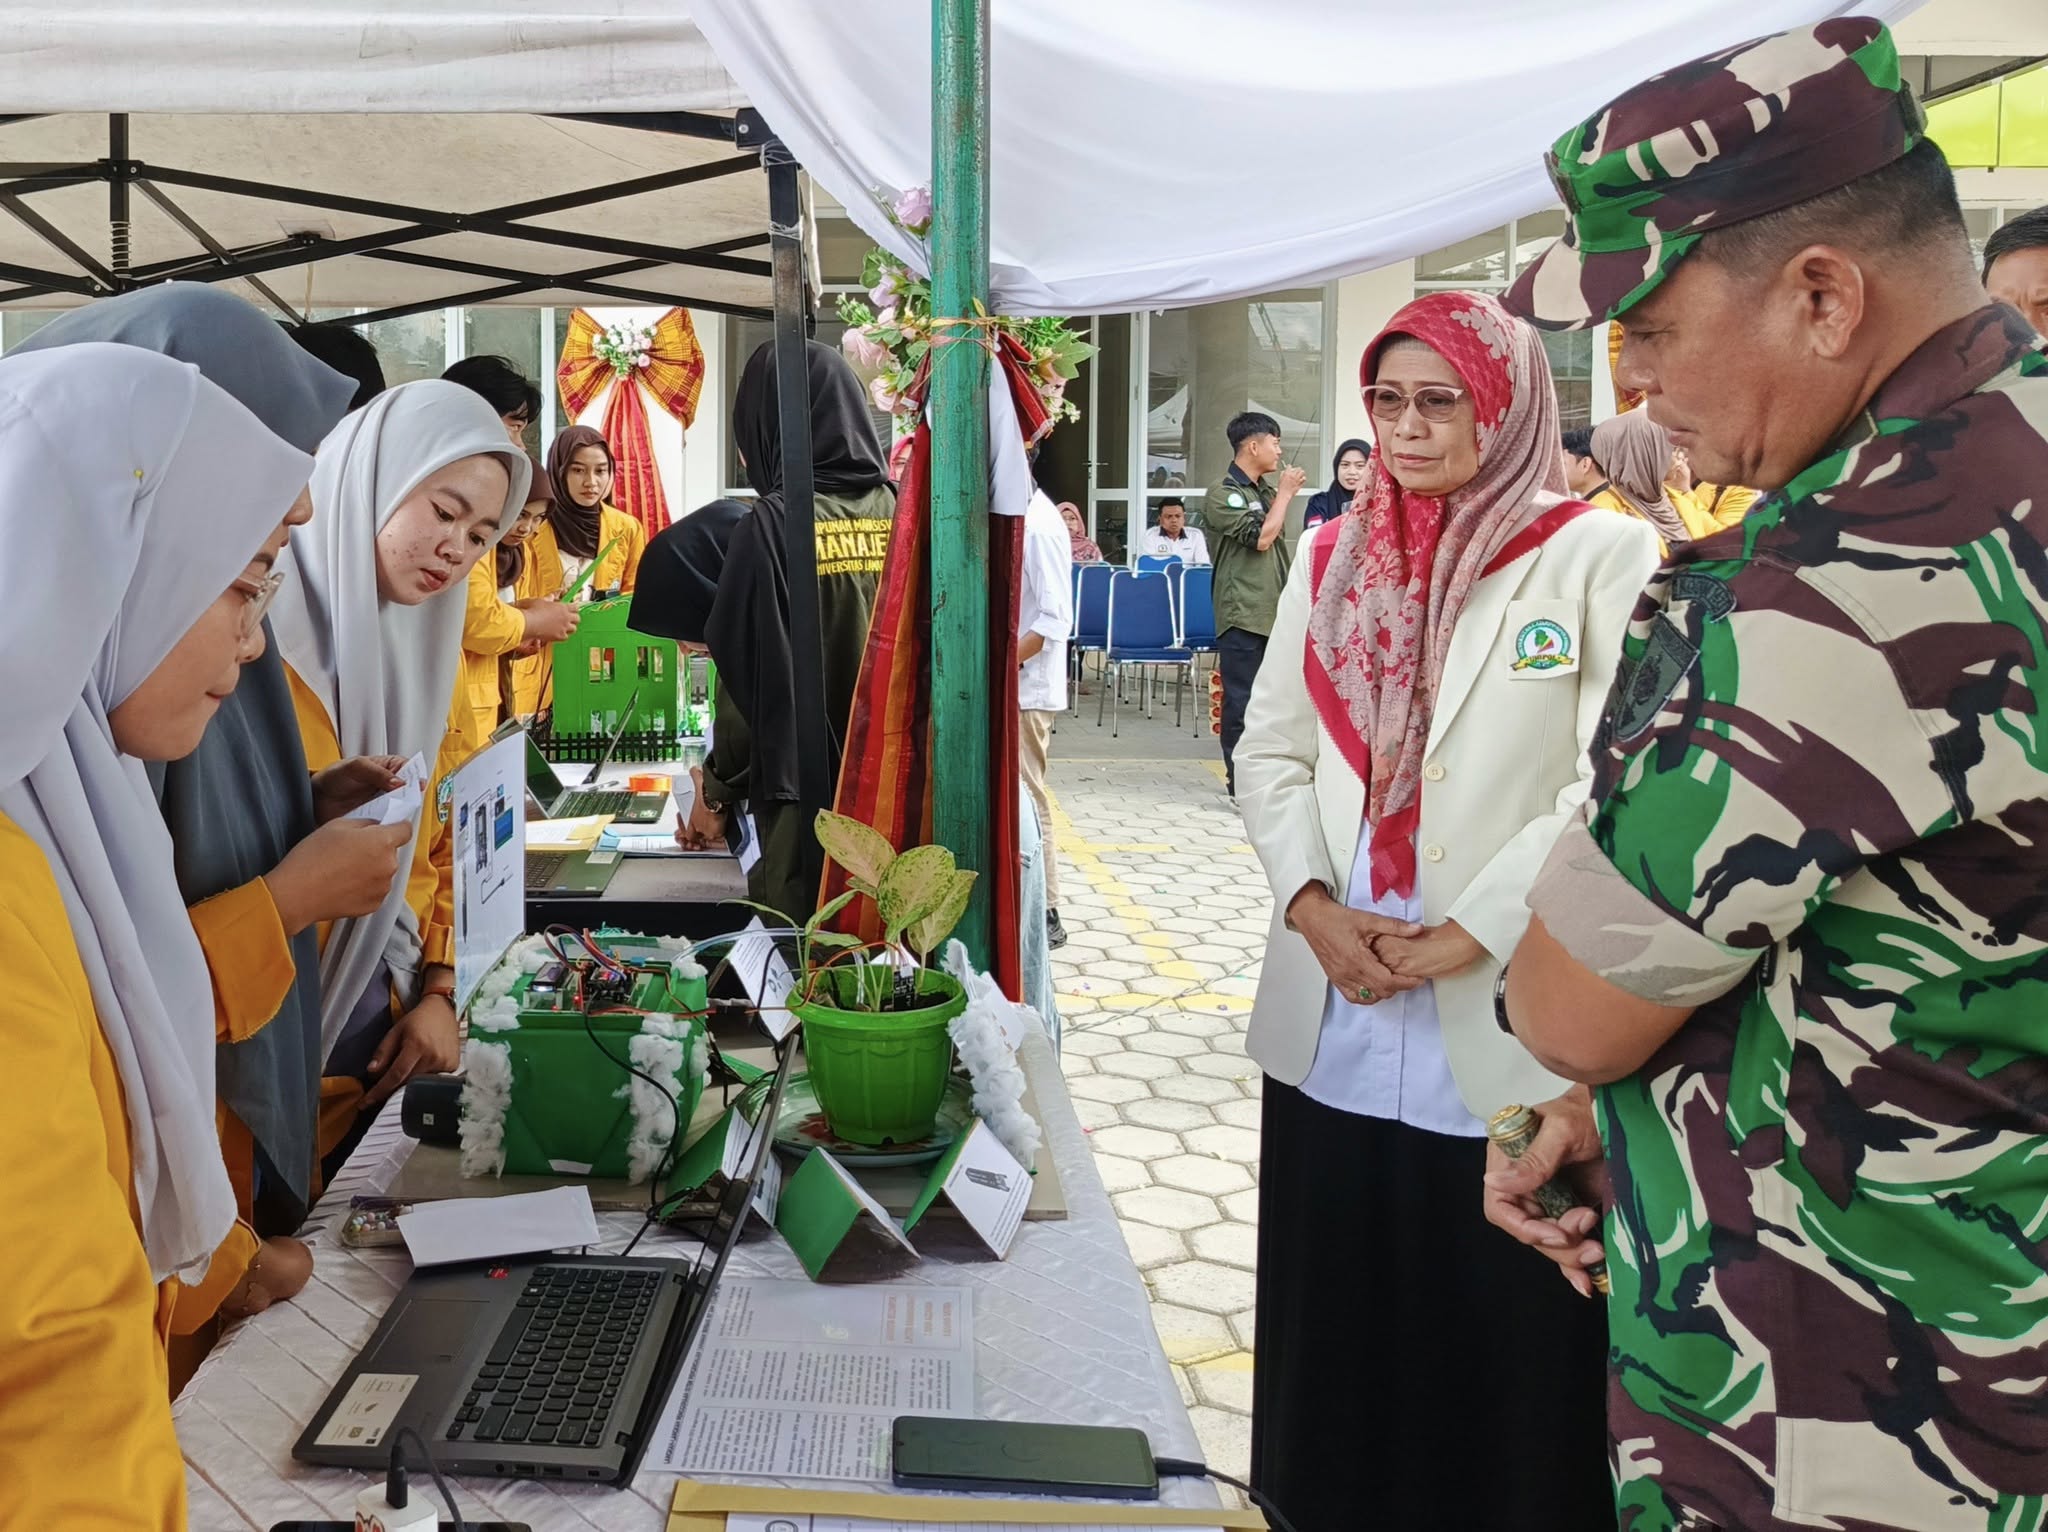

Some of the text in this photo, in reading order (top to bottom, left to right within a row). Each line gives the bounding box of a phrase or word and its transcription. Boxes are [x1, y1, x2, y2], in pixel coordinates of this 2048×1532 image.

[815, 519, 852, 533] PUNAN
[816, 533, 888, 560] MANAJE
[817, 560, 863, 576] NIVERSITAS
